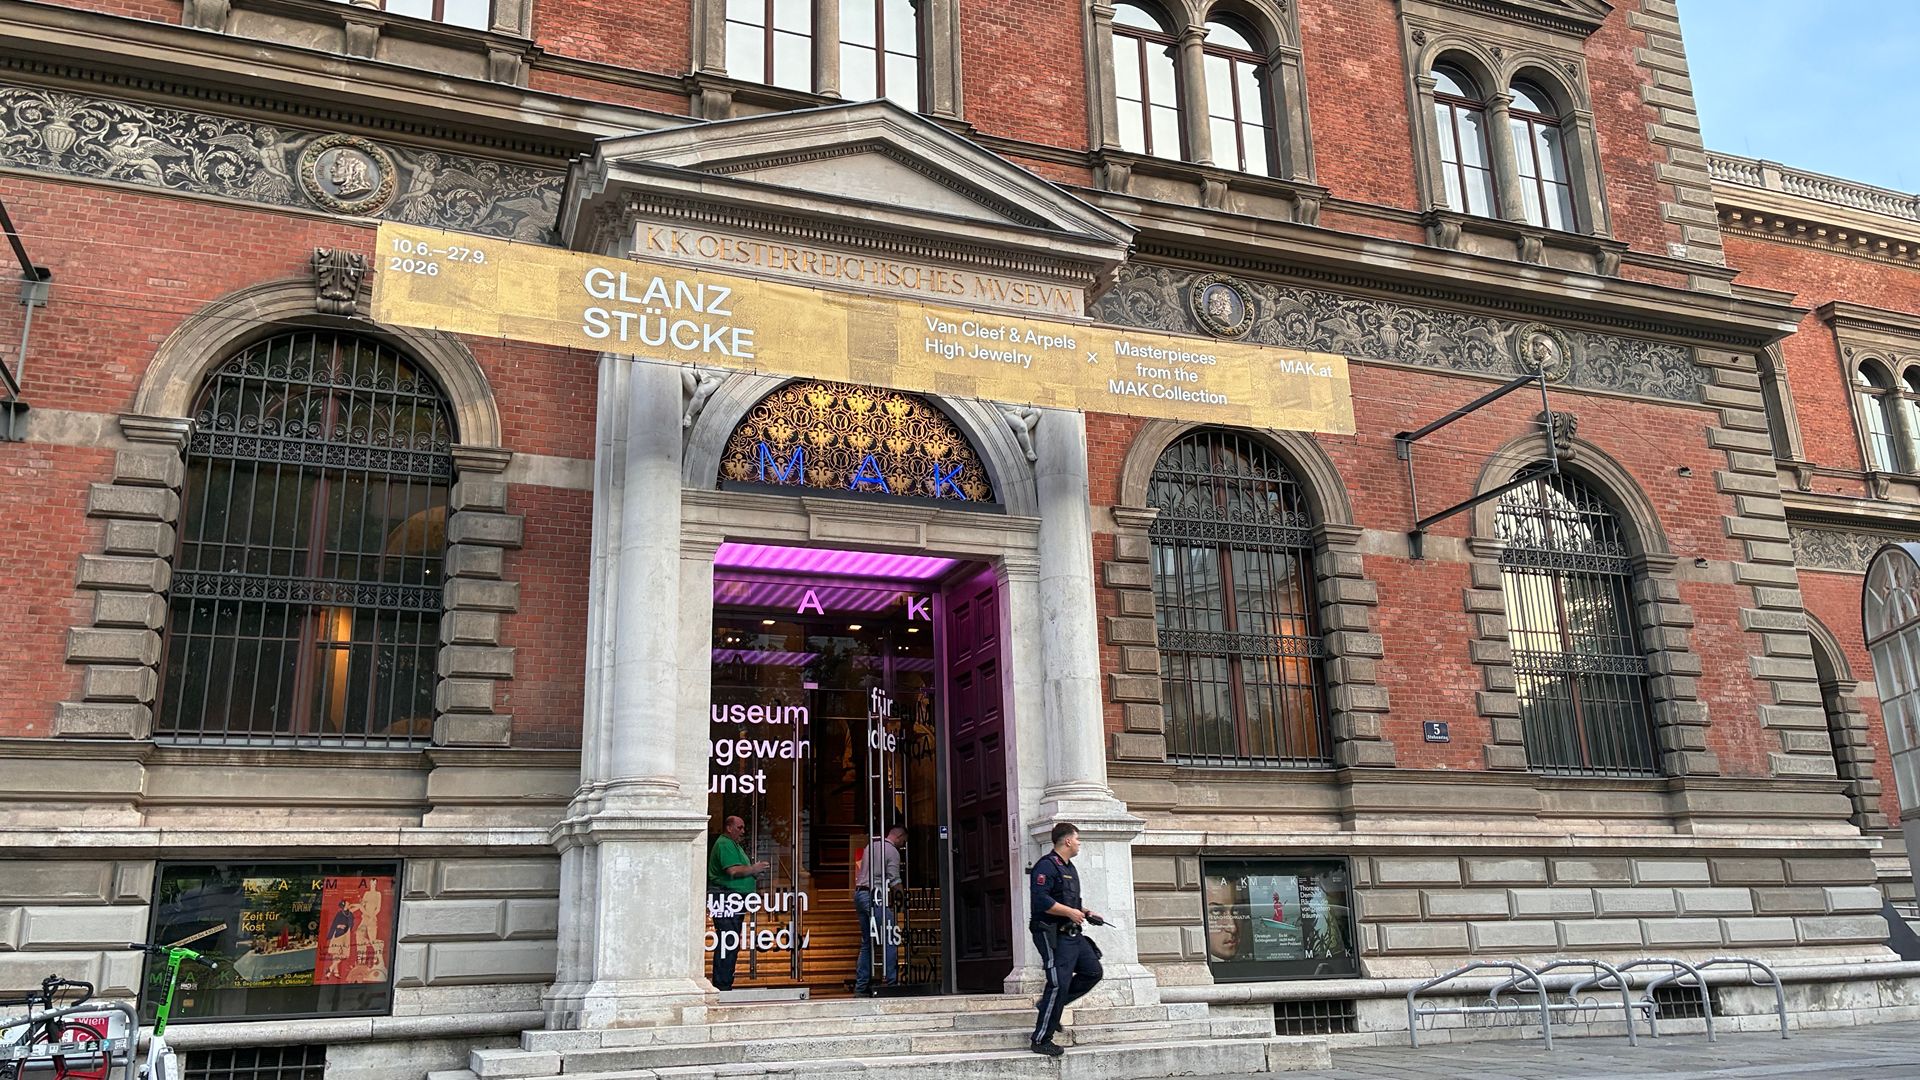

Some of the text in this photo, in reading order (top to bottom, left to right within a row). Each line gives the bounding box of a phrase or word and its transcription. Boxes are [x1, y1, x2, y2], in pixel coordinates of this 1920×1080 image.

[390, 257, 439, 276] 2026
[697, 234, 965, 295] OESTERREICHISCHES
[584, 267, 733, 317] GLANZ
[582, 307, 755, 359] STÜCKE
[925, 315, 1077, 352] Van Cleef & Arpels
[925, 338, 1033, 369] High Jewelry
[1114, 340, 1217, 367] Masterpieces
[1135, 363, 1199, 383] from the
[1279, 358, 1333, 378] MAK.at
[1108, 379, 1228, 406] MAK Collection
[711, 686, 894, 725] useum für
[1433, 723, 1441, 735] 5
[241, 922, 266, 932] Kost
[243, 911, 279, 921] Zeit für
